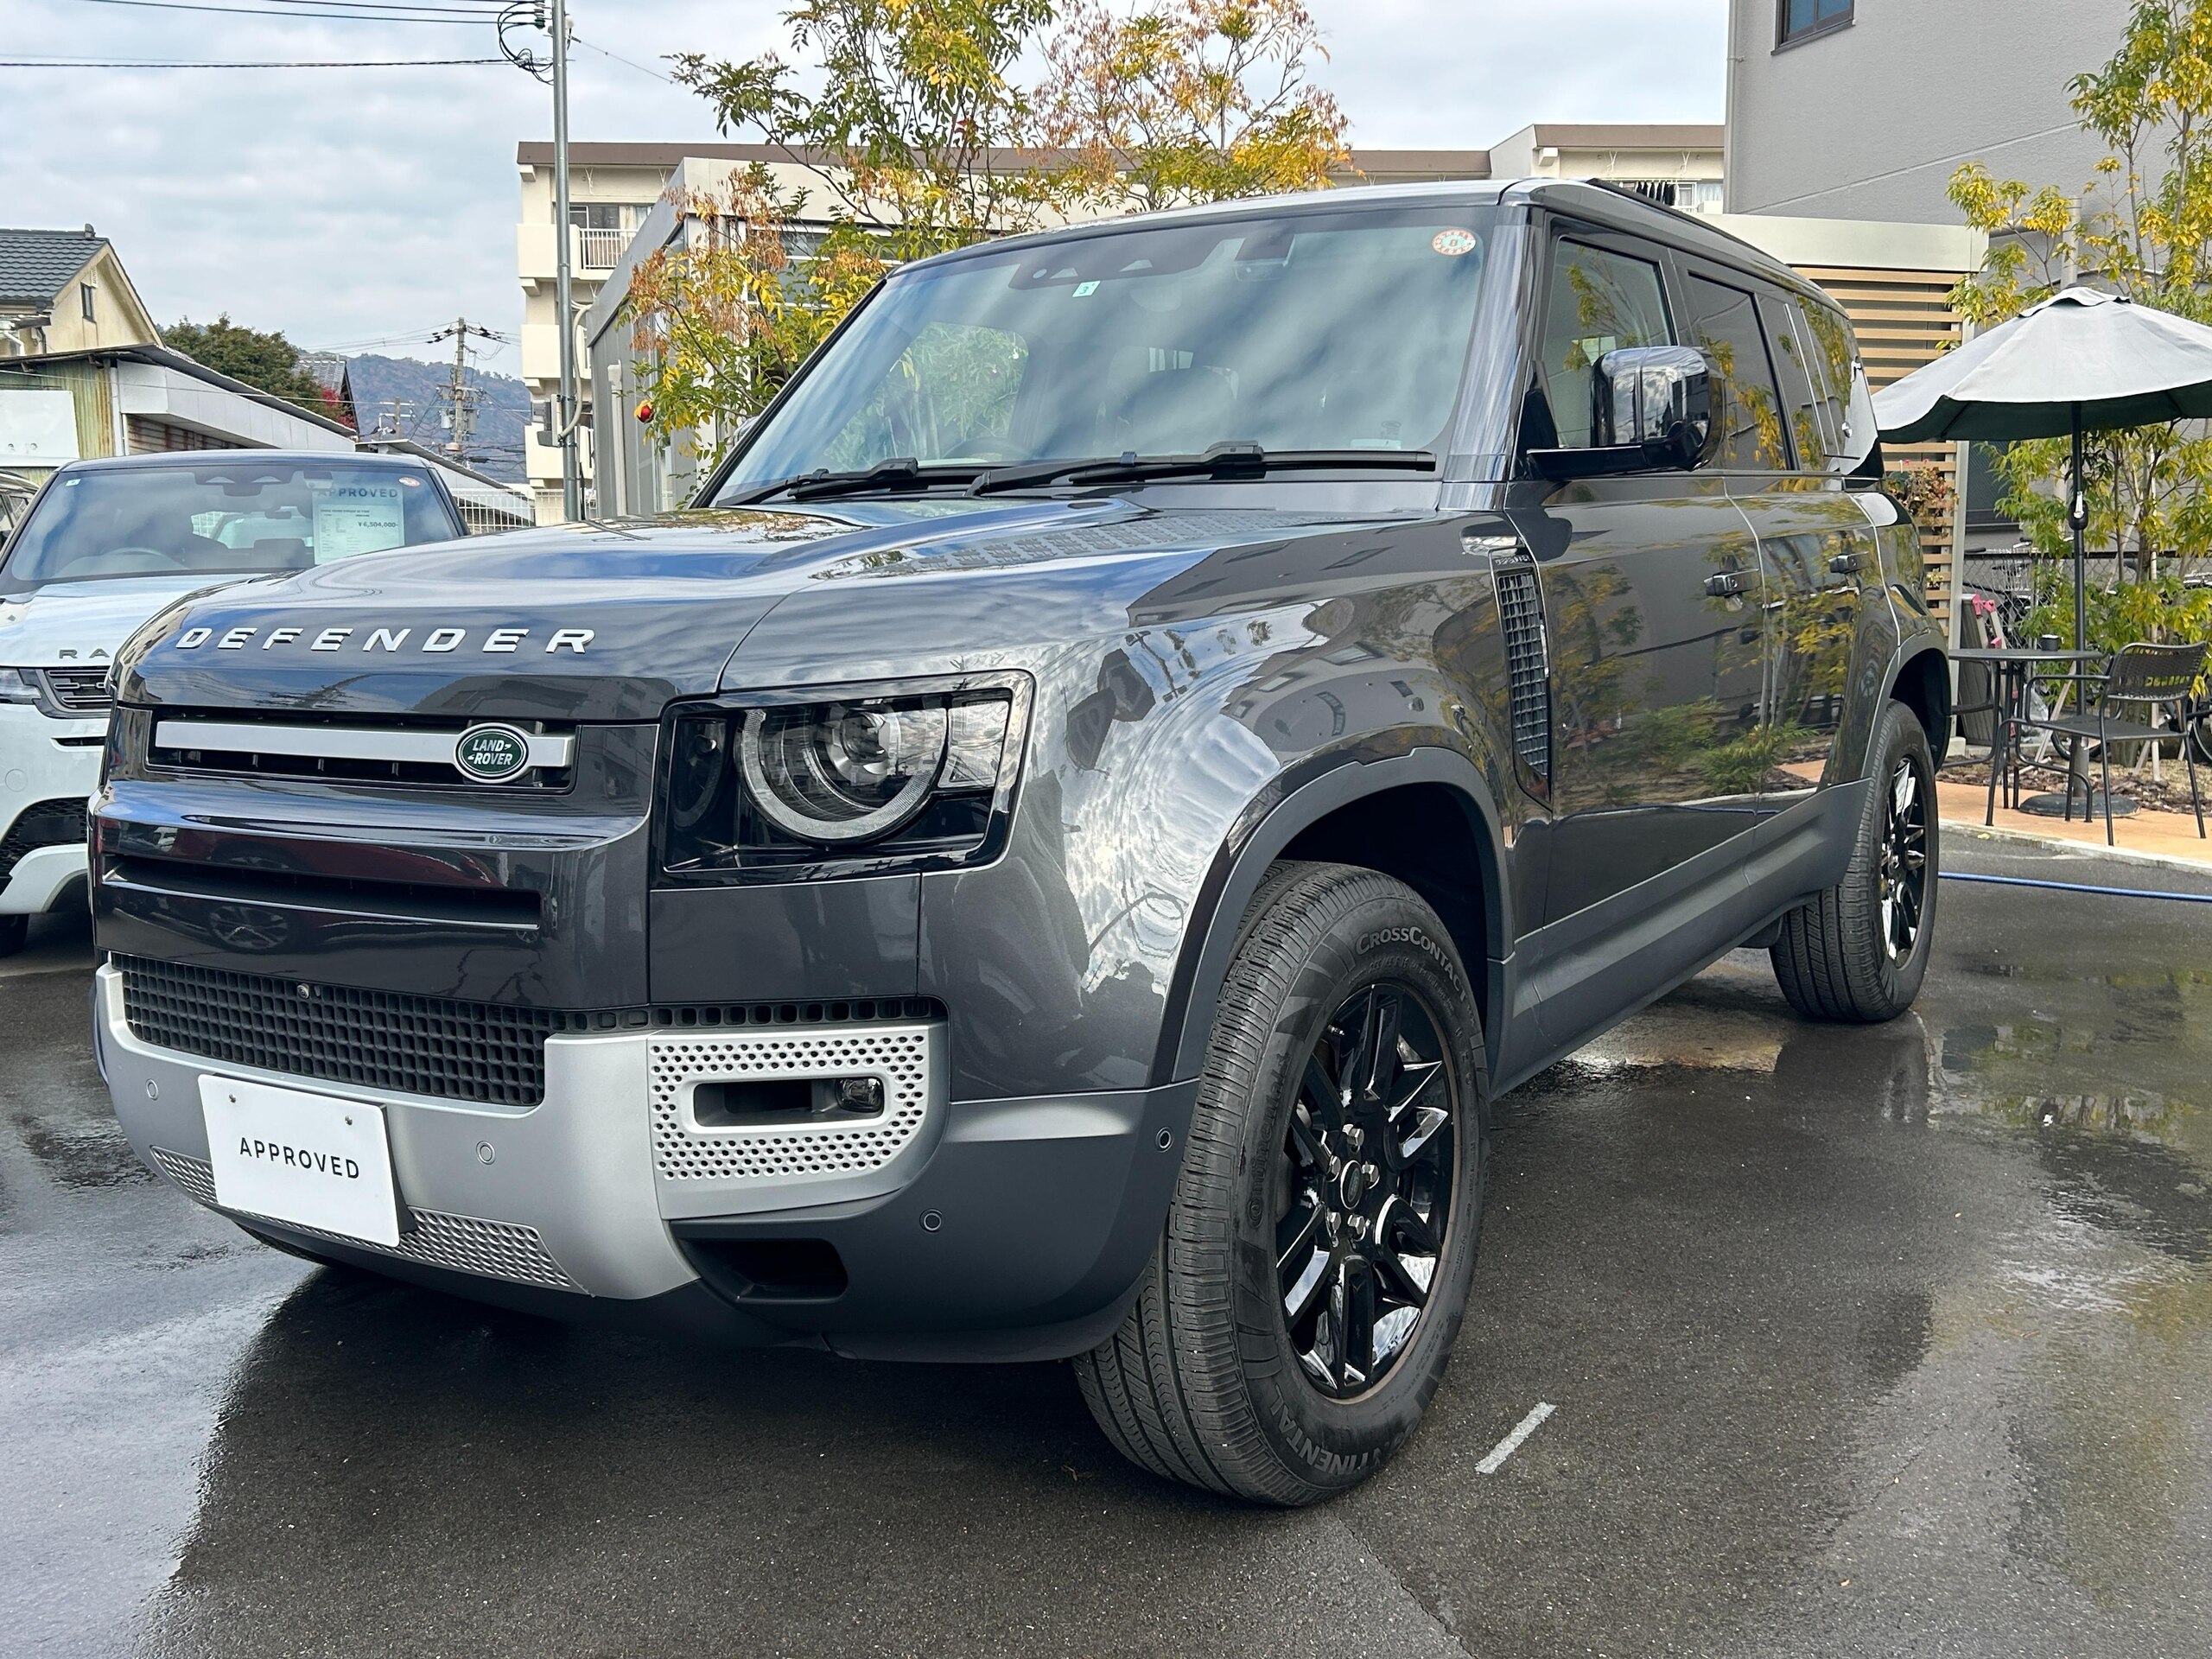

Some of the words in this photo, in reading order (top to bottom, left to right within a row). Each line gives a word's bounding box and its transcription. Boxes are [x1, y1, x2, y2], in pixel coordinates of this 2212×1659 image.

[318, 488, 397, 498] APPROVED
[175, 627, 595, 654] DEFENDER
[58, 648, 111, 659] RA
[472, 739, 505, 752] LAND
[473, 753, 513, 766] ROVER
[239, 1136, 359, 1179] APPROVED
